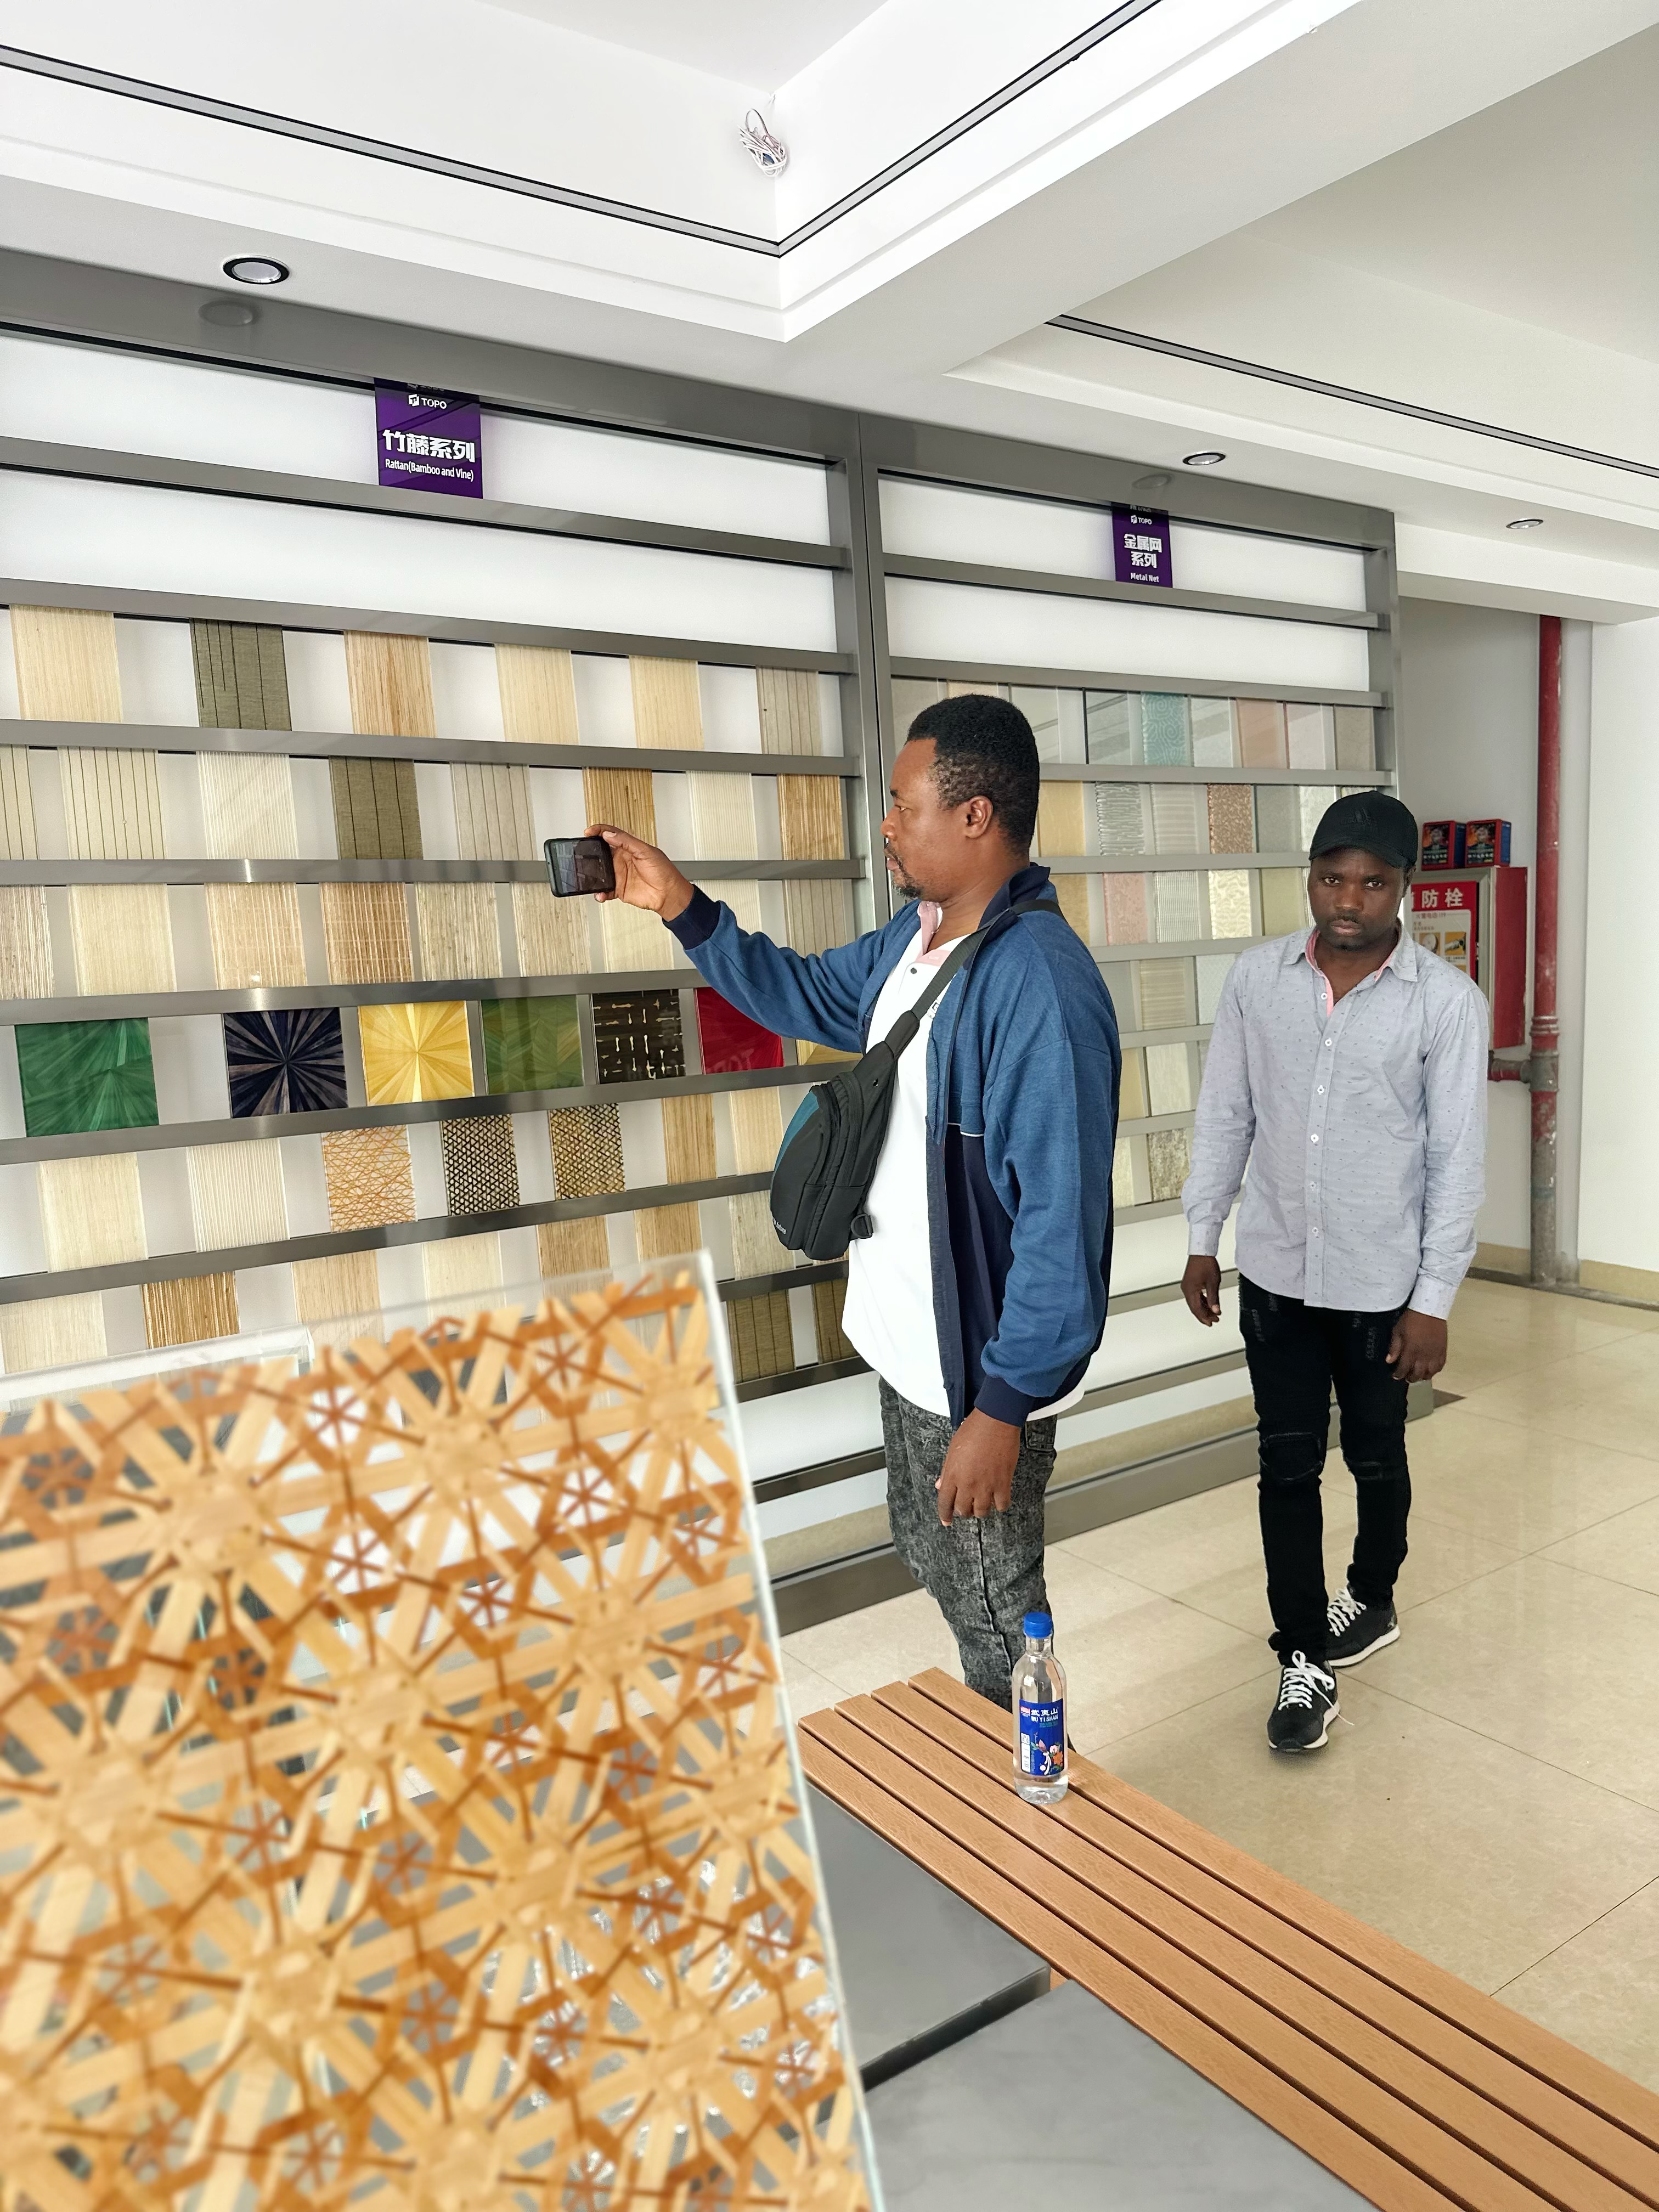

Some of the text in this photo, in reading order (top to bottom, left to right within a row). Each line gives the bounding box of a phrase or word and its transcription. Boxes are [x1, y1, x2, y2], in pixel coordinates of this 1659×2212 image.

[421, 398, 447, 409] TOPO
[382, 430, 475, 462] 竹藤系列
[385, 459, 473, 482] Rattan(Bamboo and Vine)
[1137, 517, 1153, 525] TOPO
[1124, 533, 1162, 553] 金属网
[1131, 551, 1157, 568] 系列
[1130, 572, 1148, 582] Metal
[1411, 887, 1464, 909] 防栓
